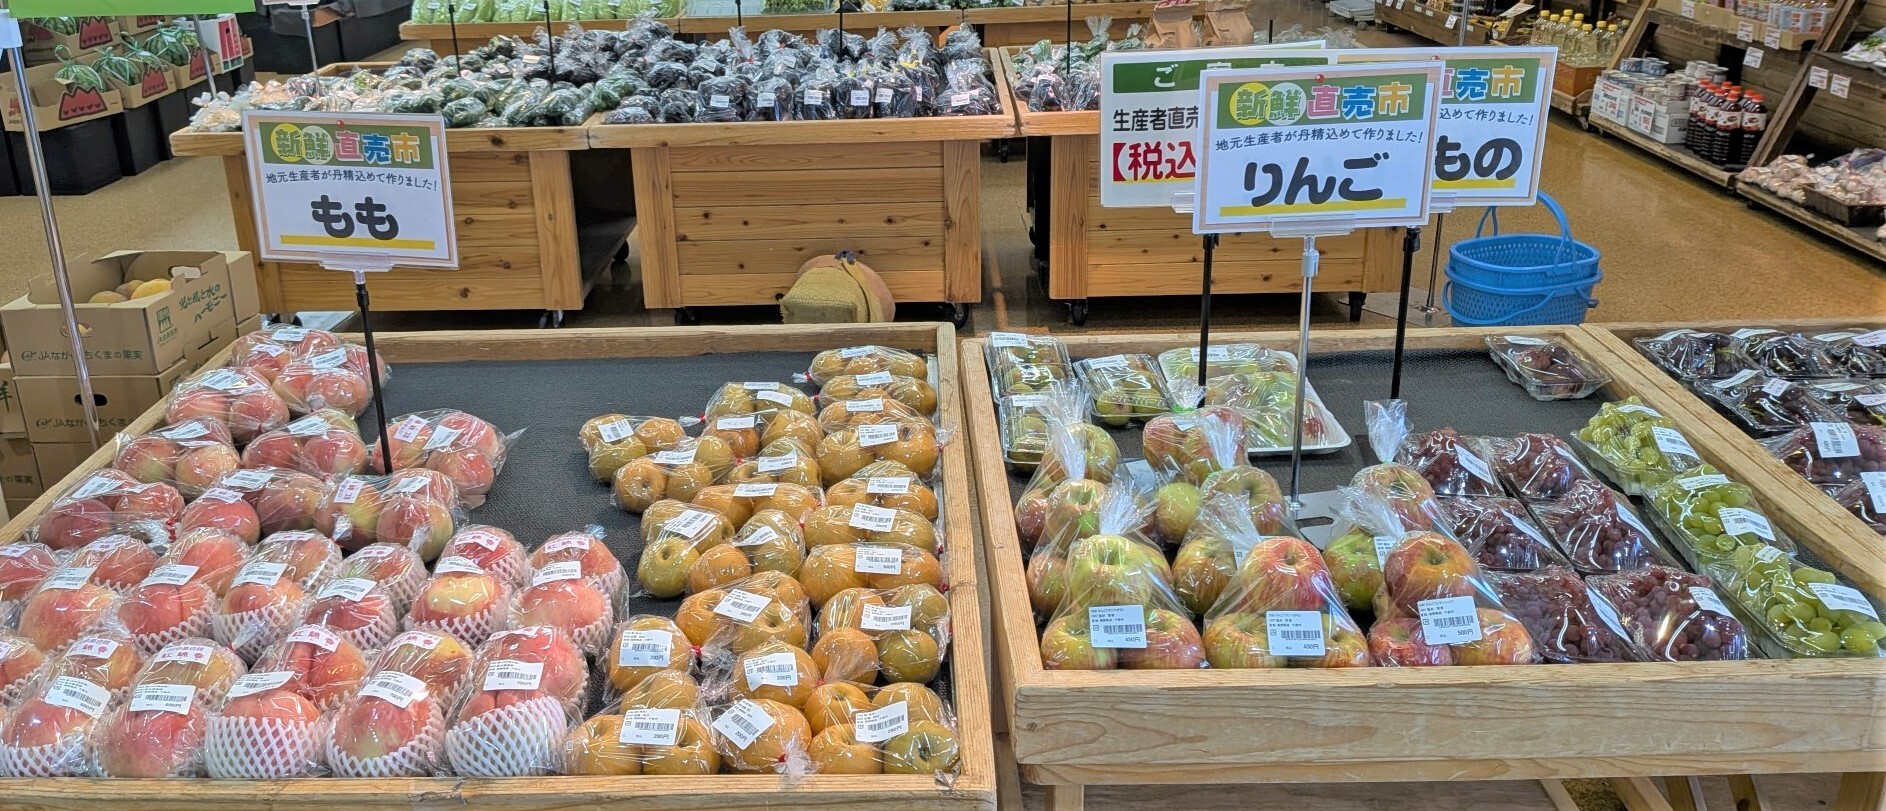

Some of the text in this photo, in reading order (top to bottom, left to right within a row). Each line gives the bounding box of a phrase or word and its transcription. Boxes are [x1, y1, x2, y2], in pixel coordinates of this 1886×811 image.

[1235, 81, 1413, 122] 新鮮直売市
[274, 128, 421, 164] 新鮮直売市
[1216, 131, 1423, 152] 地元生産者が丹精込めて作りました!
[1435, 135, 1523, 181] もの
[266, 169, 438, 191] 地元生産者が丹精込めて作りました!
[1244, 152, 1390, 208] りんご
[311, 194, 399, 240] もも
